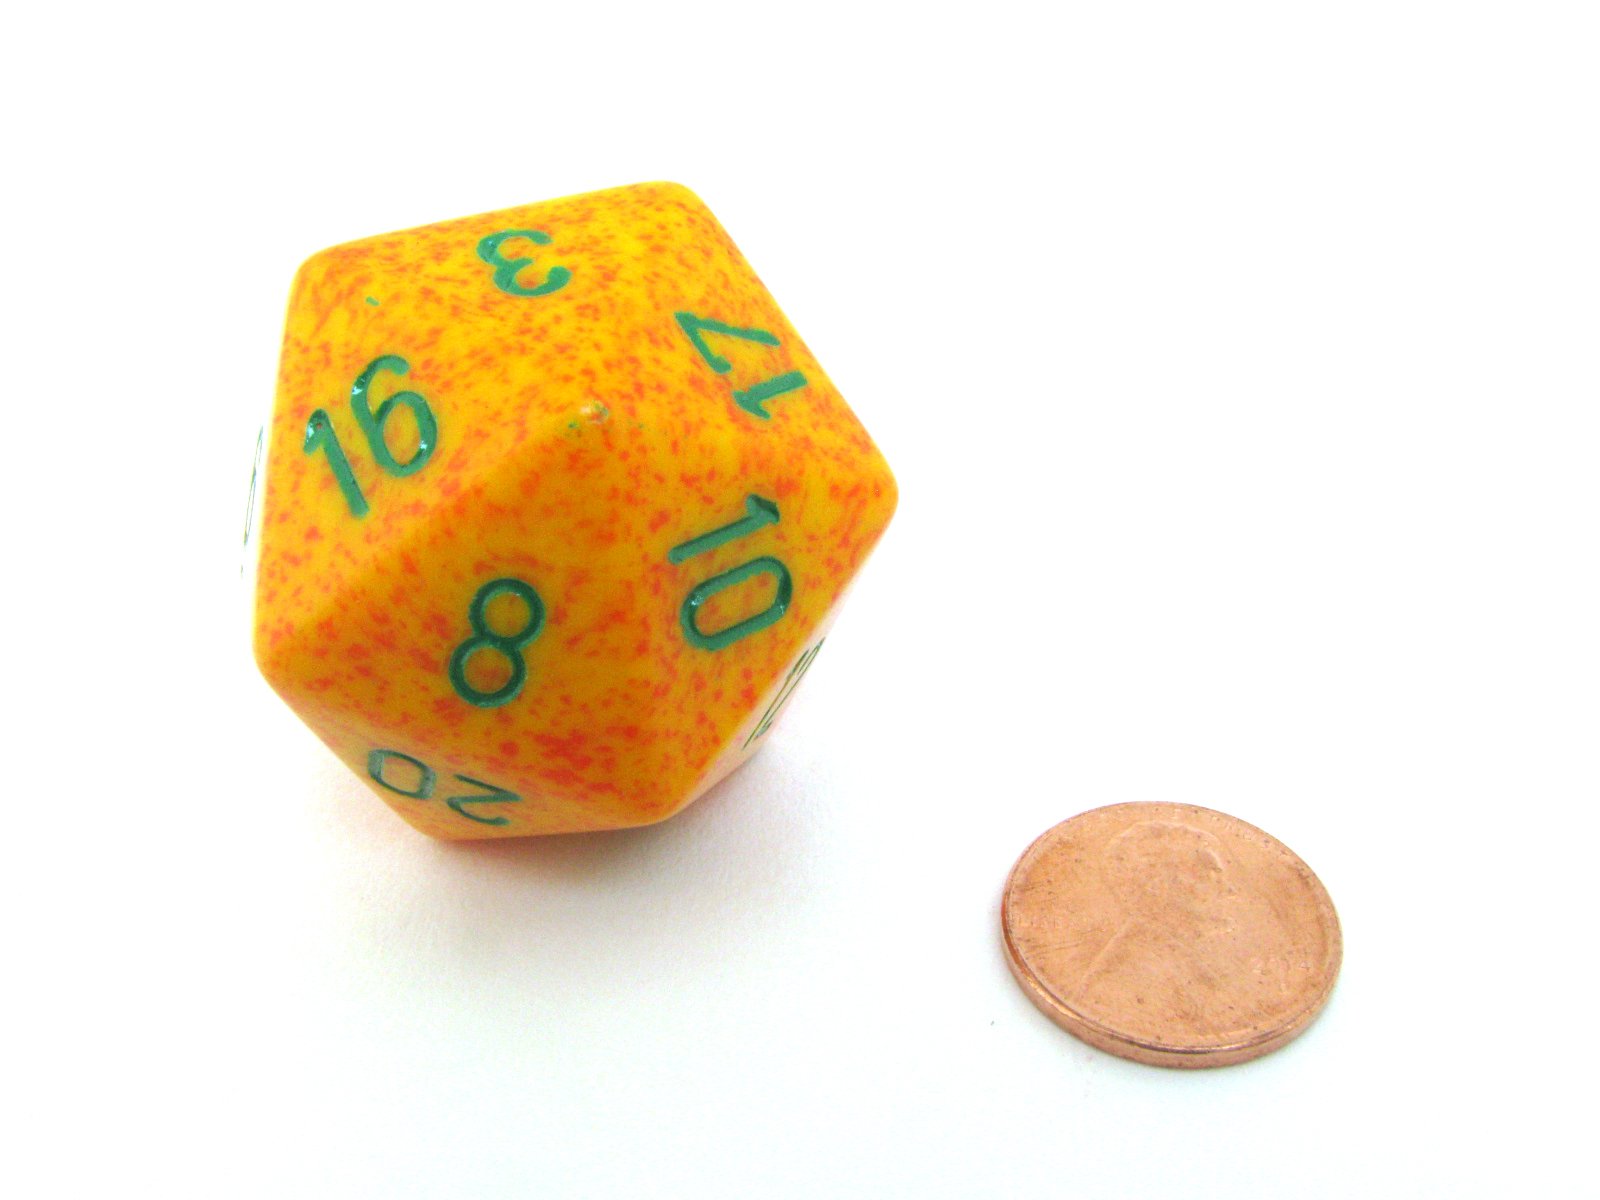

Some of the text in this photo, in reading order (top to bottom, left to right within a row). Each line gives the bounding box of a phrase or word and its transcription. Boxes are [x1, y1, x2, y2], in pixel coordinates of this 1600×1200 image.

[477, 231, 571, 297] 3
[676, 312, 806, 419] 17
[303, 355, 438, 517] 16
[669, 495, 793, 651] 10
[449, 578, 545, 708] 8
[367, 748, 523, 826] 20
